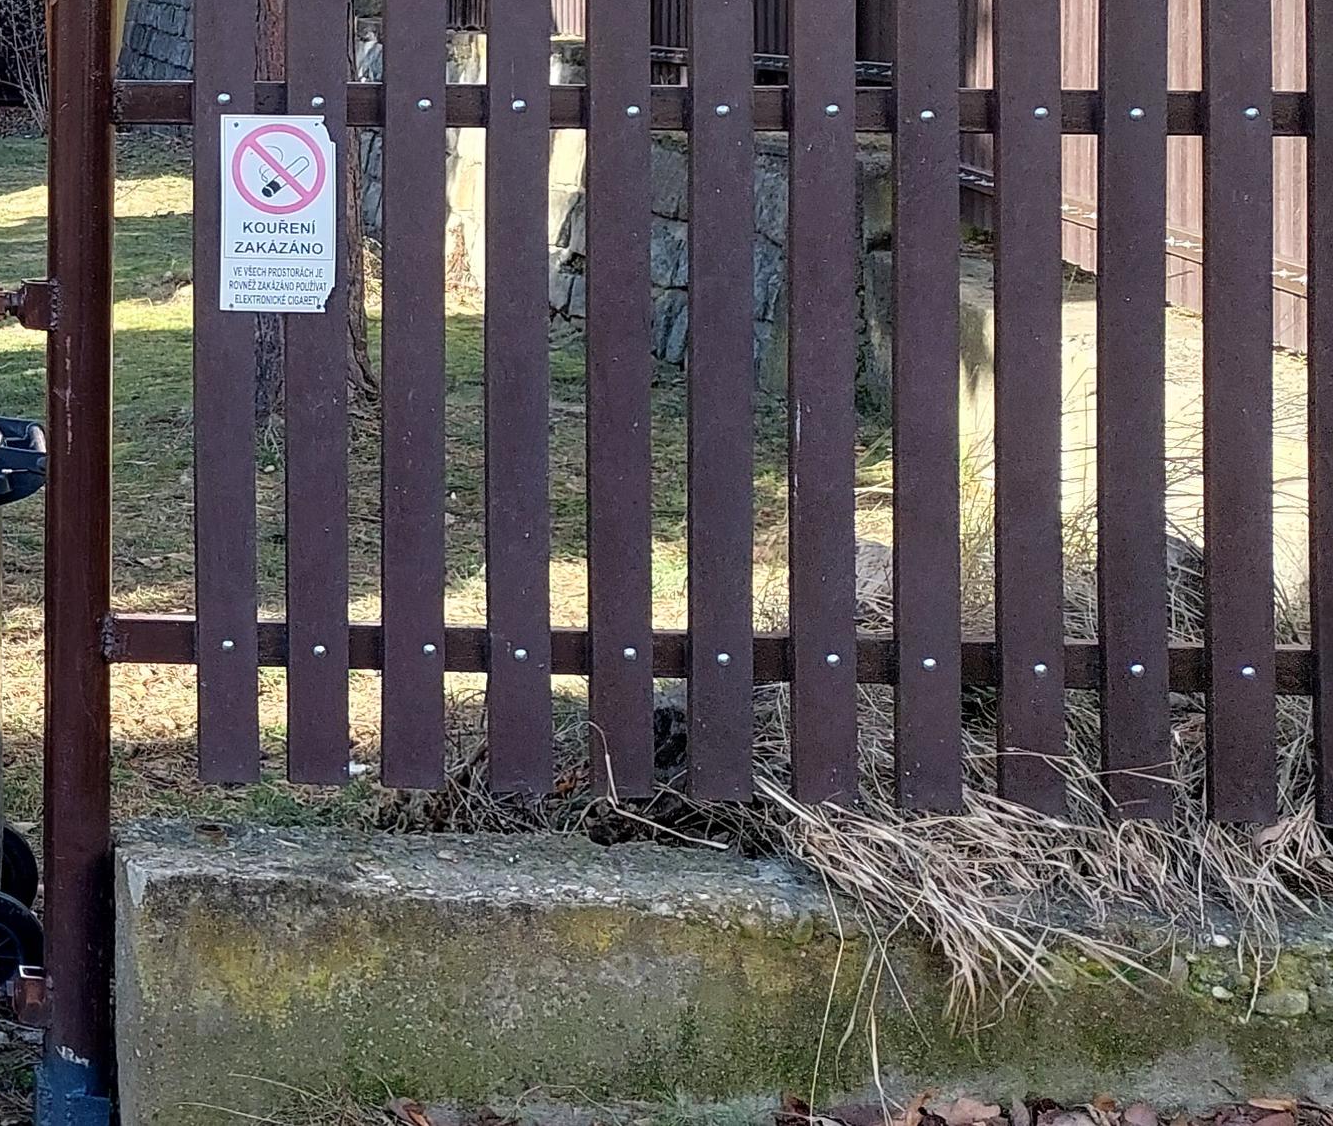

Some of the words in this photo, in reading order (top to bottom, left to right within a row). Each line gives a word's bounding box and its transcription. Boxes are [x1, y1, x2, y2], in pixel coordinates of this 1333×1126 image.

[242, 220, 315, 234] KOUŘENÍ
[234, 240, 323, 254] ZAKÁZÁNO
[233, 267, 242, 277] VE
[244, 265, 267, 277] VŠECH
[268, 266, 313, 278] PROSTORÁCH
[315, 268, 323, 278] JE
[229, 279, 256, 291] ROVNĚŽ
[258, 280, 294, 291] ZAKÁZÁNO
[296, 280, 327, 292] POUŽÍVAT
[235, 294, 286, 305] ELEKTRONICKÉ
